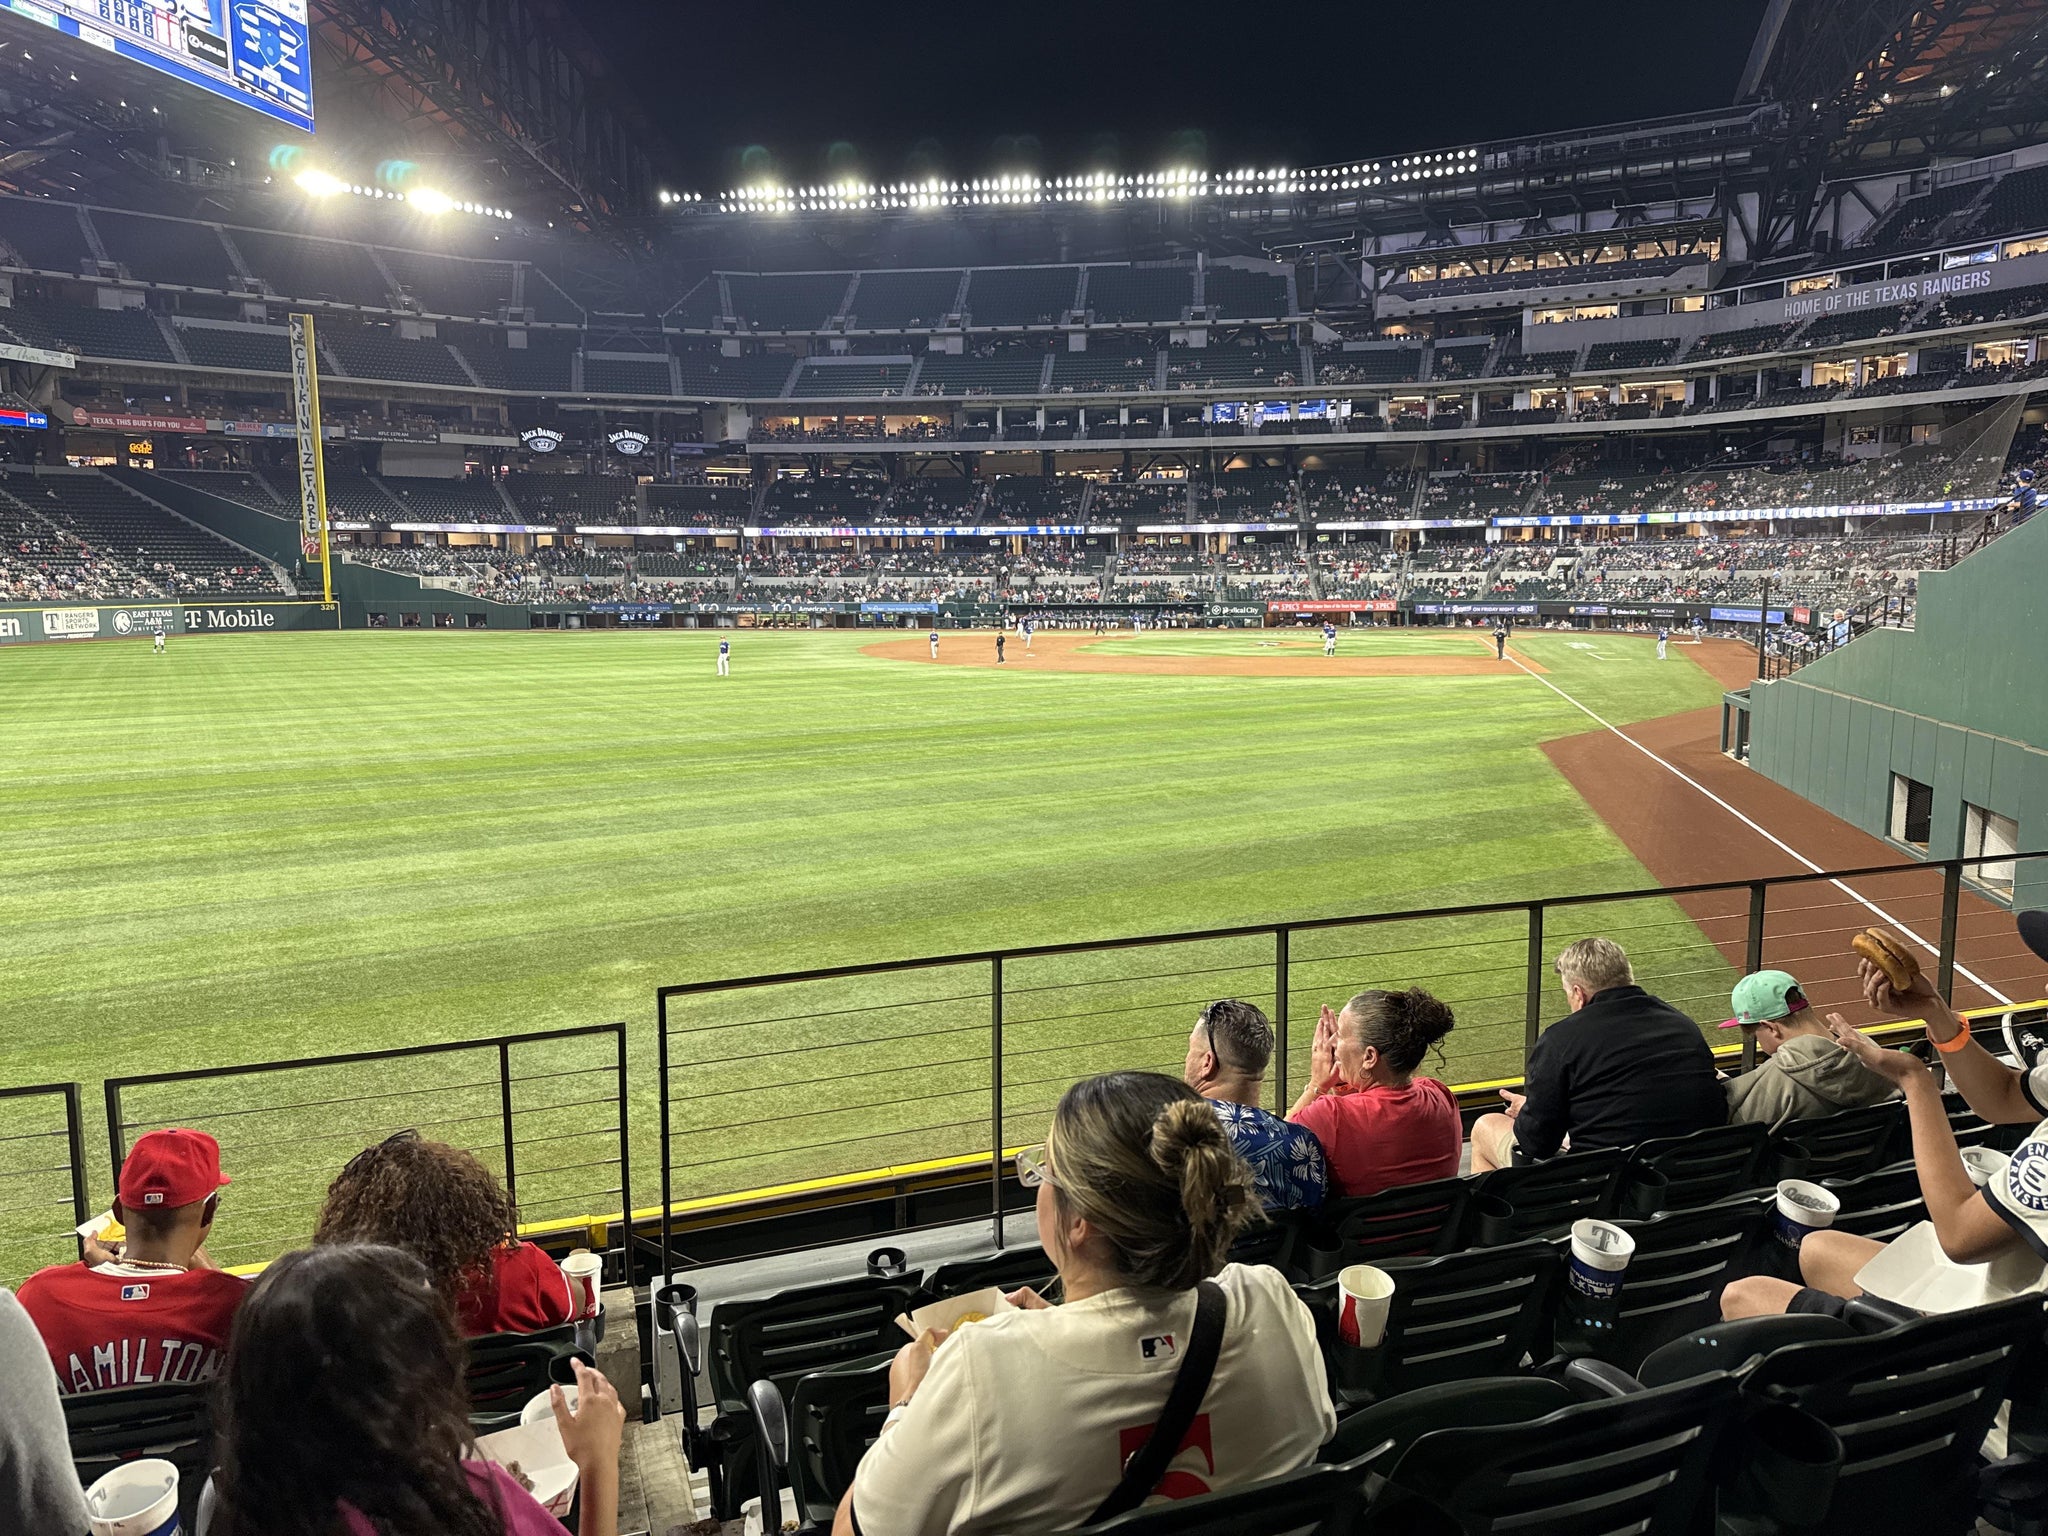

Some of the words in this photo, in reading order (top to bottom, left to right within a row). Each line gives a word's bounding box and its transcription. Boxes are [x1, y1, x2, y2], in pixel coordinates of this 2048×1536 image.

[102, 7, 109, 18] 2
[116, 13, 123, 25] 4
[131, 20, 138, 30] 1
[145, 27, 152, 38] 5
[145, 13, 152, 23] 2
[1784, 299, 1820, 318] HOME
[1825, 295, 1842, 312] OF
[1845, 290, 1870, 308] THE
[1875, 282, 1917, 302] TEXAS
[1923, 270, 1991, 296] RANGERS
[92, 417, 115, 426] TEXAS,
[521, 429, 537, 442] JACK
[537, 427, 564, 442] DANIEL'S
[607, 431, 623, 444] JACK
[624, 429, 650, 444] DANIEL'S
[1246, 606, 1259, 615] City
[1375, 602, 1396, 610] SPEC'S
[65, 612, 94, 620] RANGERS
[151, 609, 172, 617] TEXAS
[65, 617, 89, 625] SPORTS
[144, 617, 162, 625] A&M
[207, 609, 274, 628] Mobile
[2028, 1143, 2048, 1161] EN
